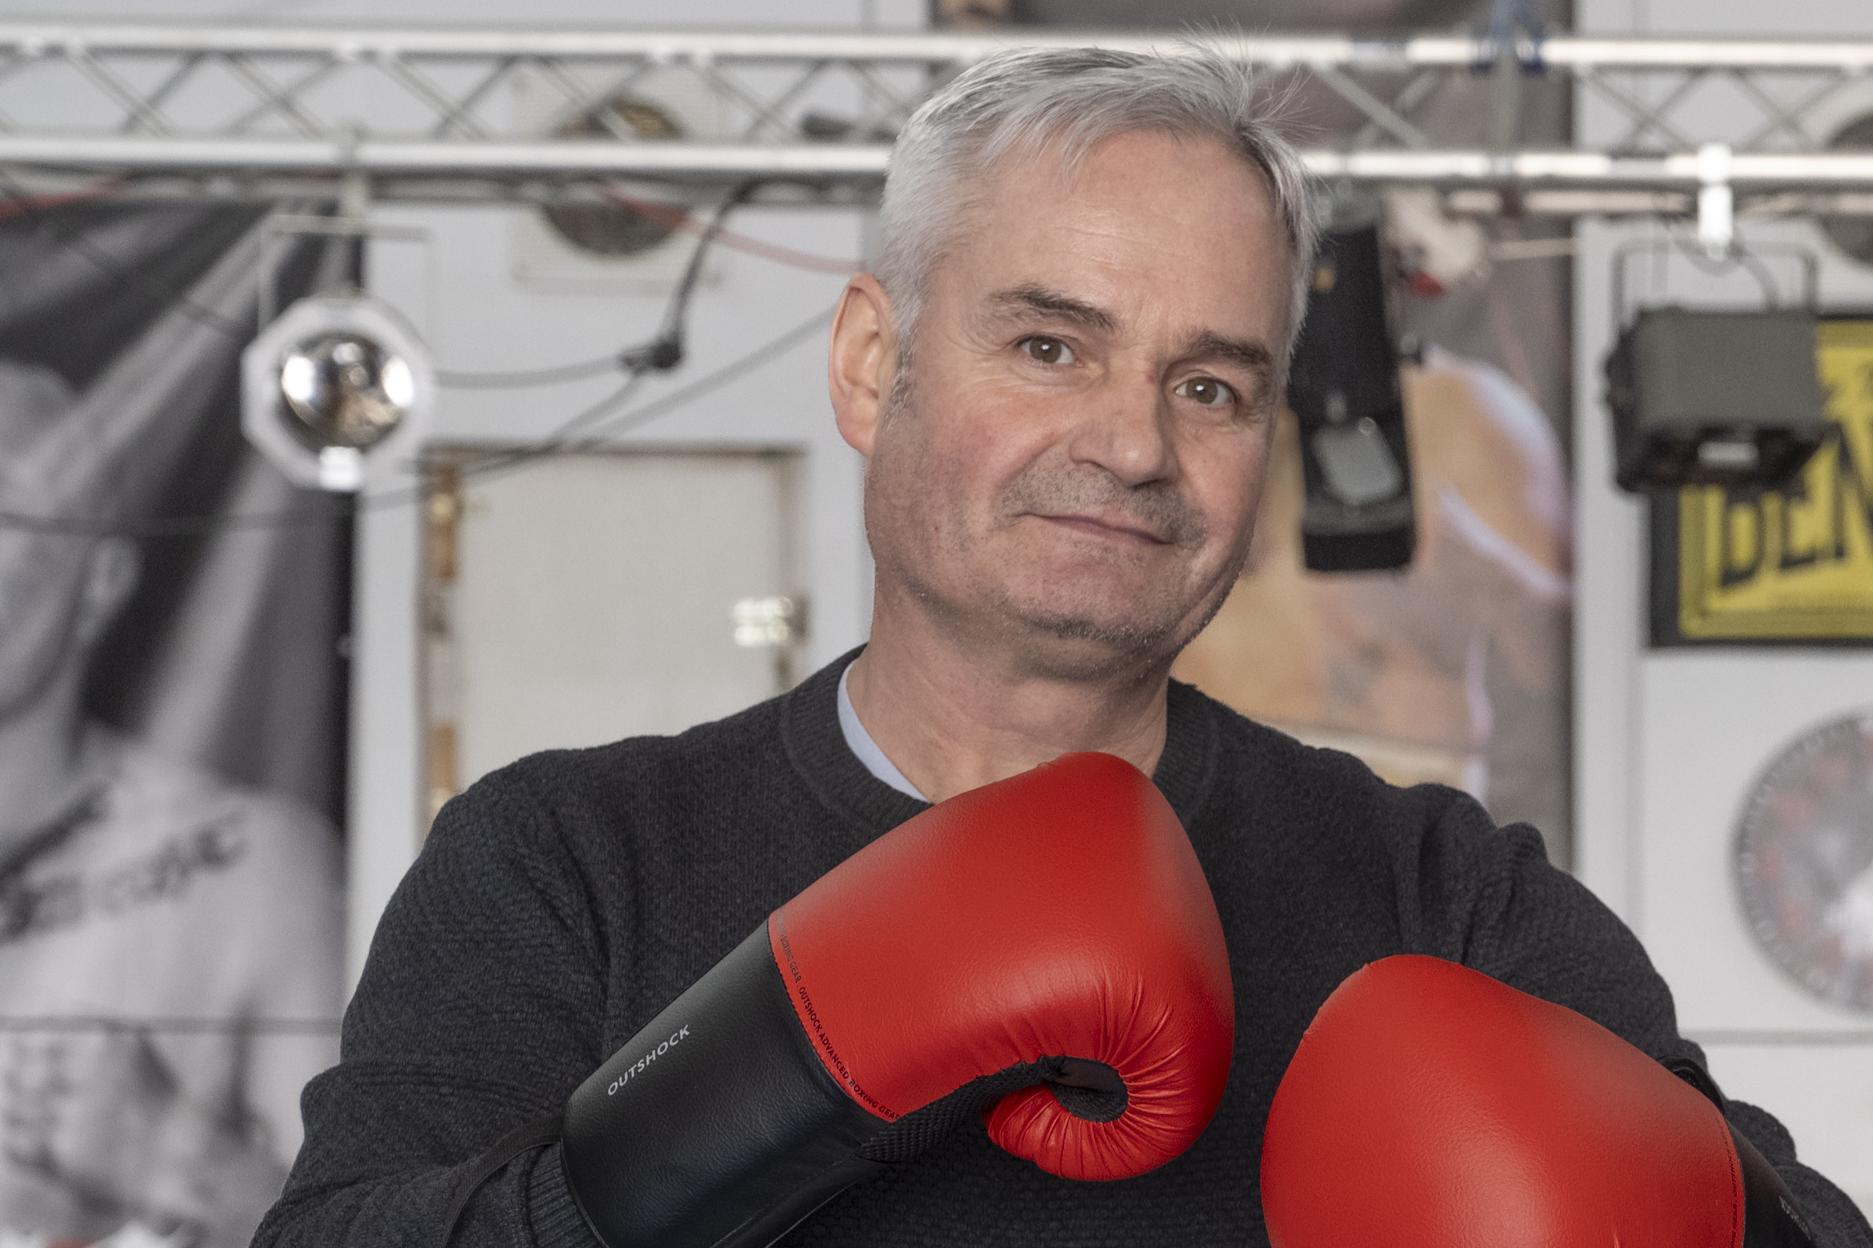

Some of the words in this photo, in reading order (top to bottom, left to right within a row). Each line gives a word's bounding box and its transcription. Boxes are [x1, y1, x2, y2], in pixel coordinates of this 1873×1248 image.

[607, 1023, 690, 1096] OUTSHOCK
[789, 961, 802, 983] GEAR
[798, 986, 823, 1033] OUTSHOCK
[819, 1032, 850, 1080] ADVANCED
[848, 1078, 880, 1109] BOXING
